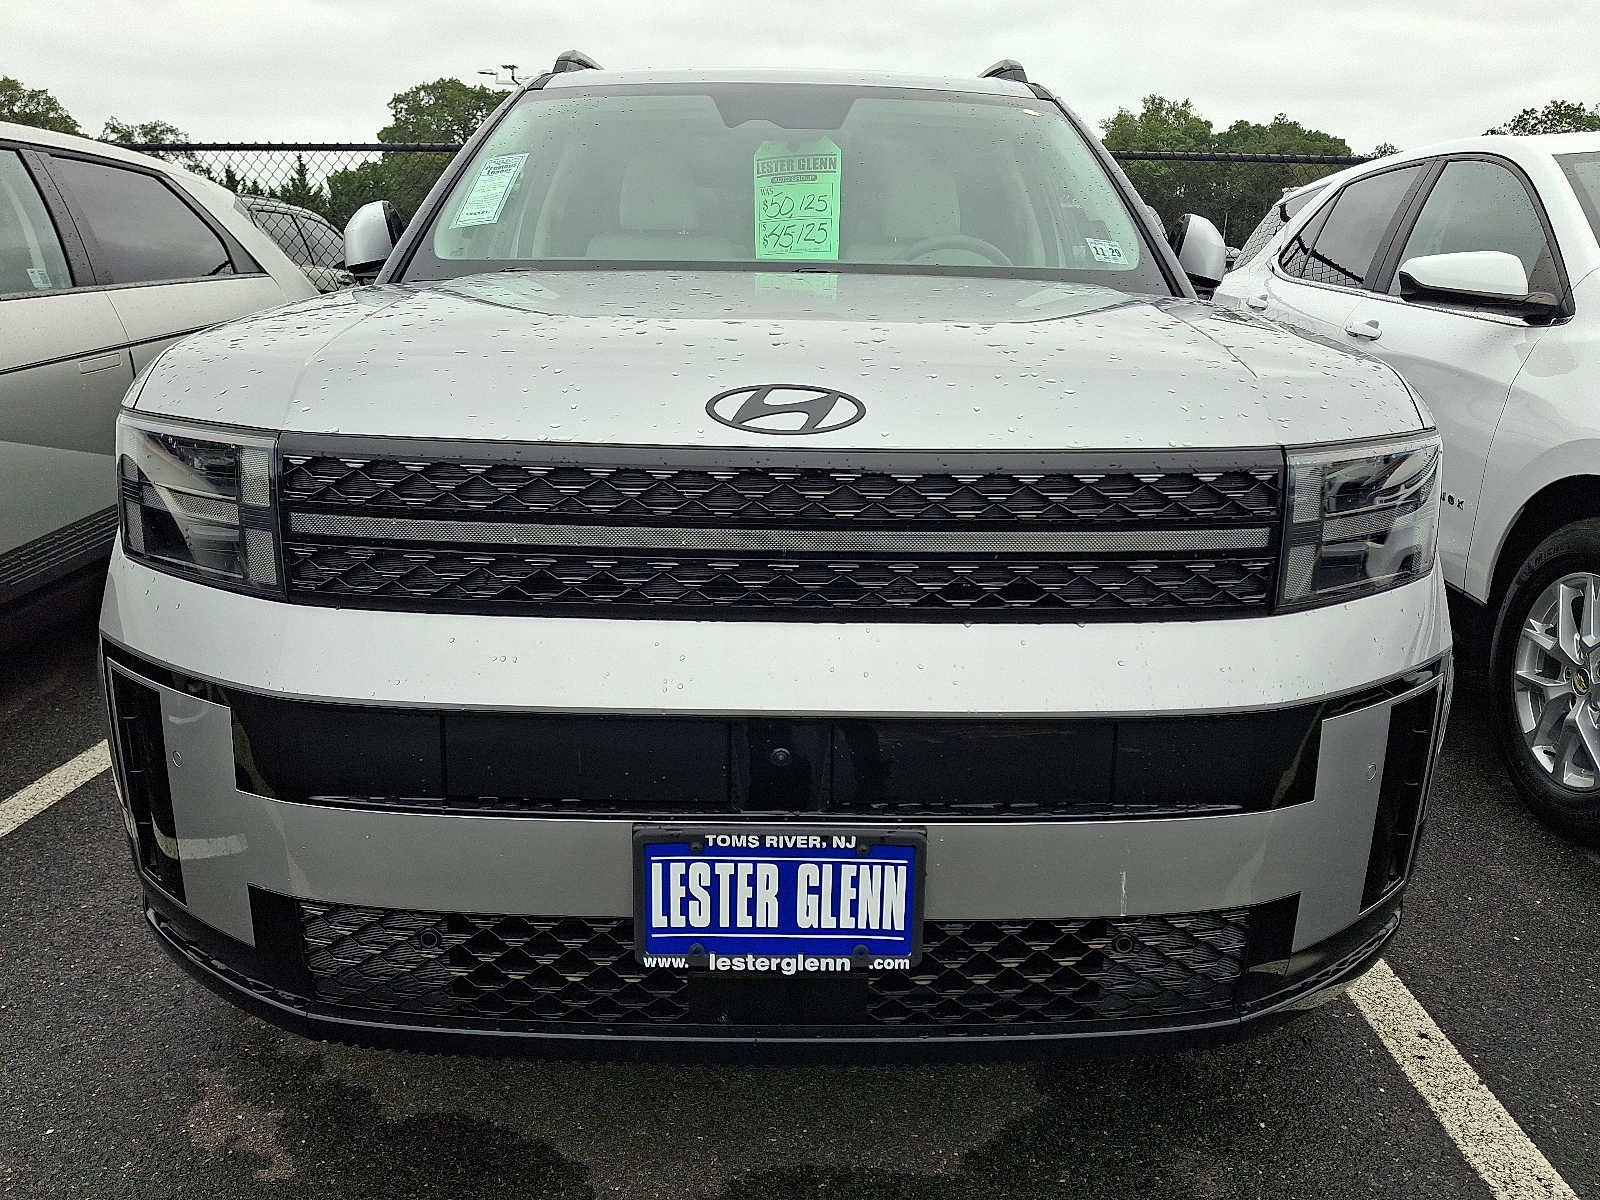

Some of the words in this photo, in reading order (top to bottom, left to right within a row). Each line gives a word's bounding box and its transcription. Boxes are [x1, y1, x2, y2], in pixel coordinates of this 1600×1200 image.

[757, 159, 795, 175] LESTER
[797, 157, 837, 171] GLENN
[1093, 246, 1107, 257] 11
[1108, 247, 1122, 258] 29
[705, 834, 760, 849] TOMS
[765, 835, 827, 849] RIVER,
[832, 835, 857, 849] NJ
[651, 861, 779, 928] LESTER
[796, 862, 907, 931] GLENN
[643, 956, 689, 969] www.
[709, 953, 851, 976] lesterglenn
[868, 955, 910, 970] .com
